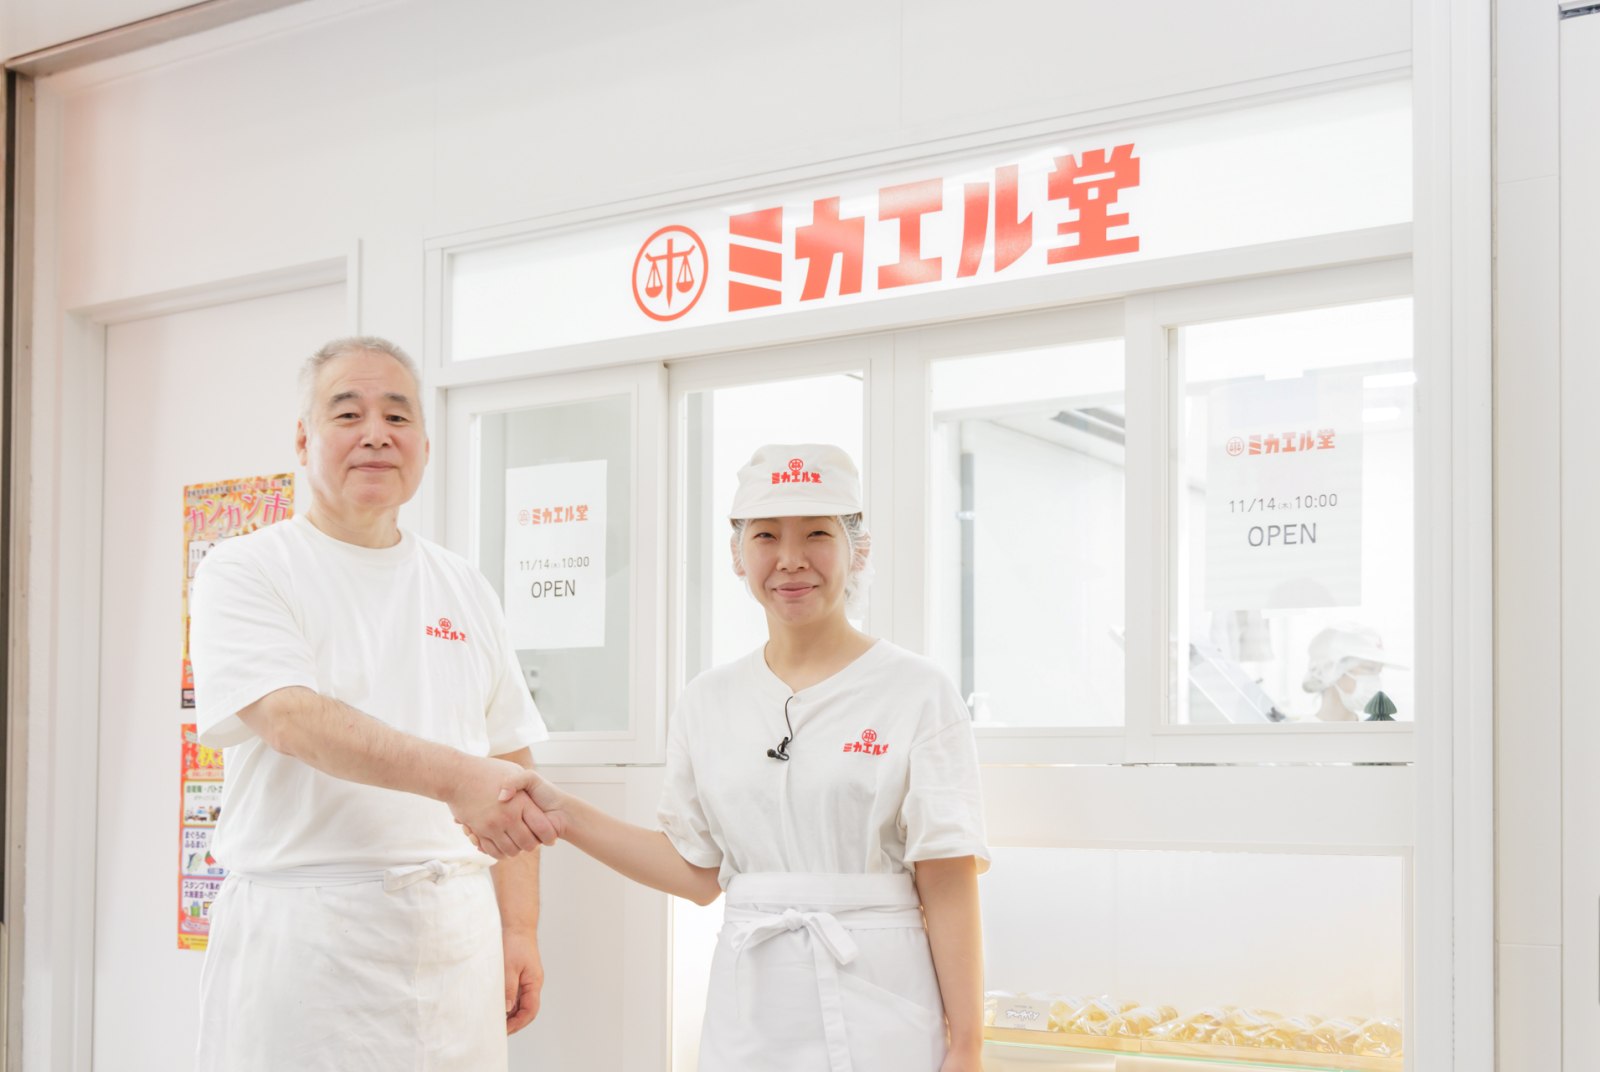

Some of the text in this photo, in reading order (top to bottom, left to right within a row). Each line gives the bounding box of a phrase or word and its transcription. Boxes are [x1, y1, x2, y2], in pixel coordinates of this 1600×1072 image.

[728, 143, 1141, 313] ミカエル堂
[1248, 428, 1336, 456] ミカエル堂
[532, 504, 589, 525] ミカエル堂
[1248, 522, 1317, 547] OPEN
[531, 579, 576, 599] OPEN
